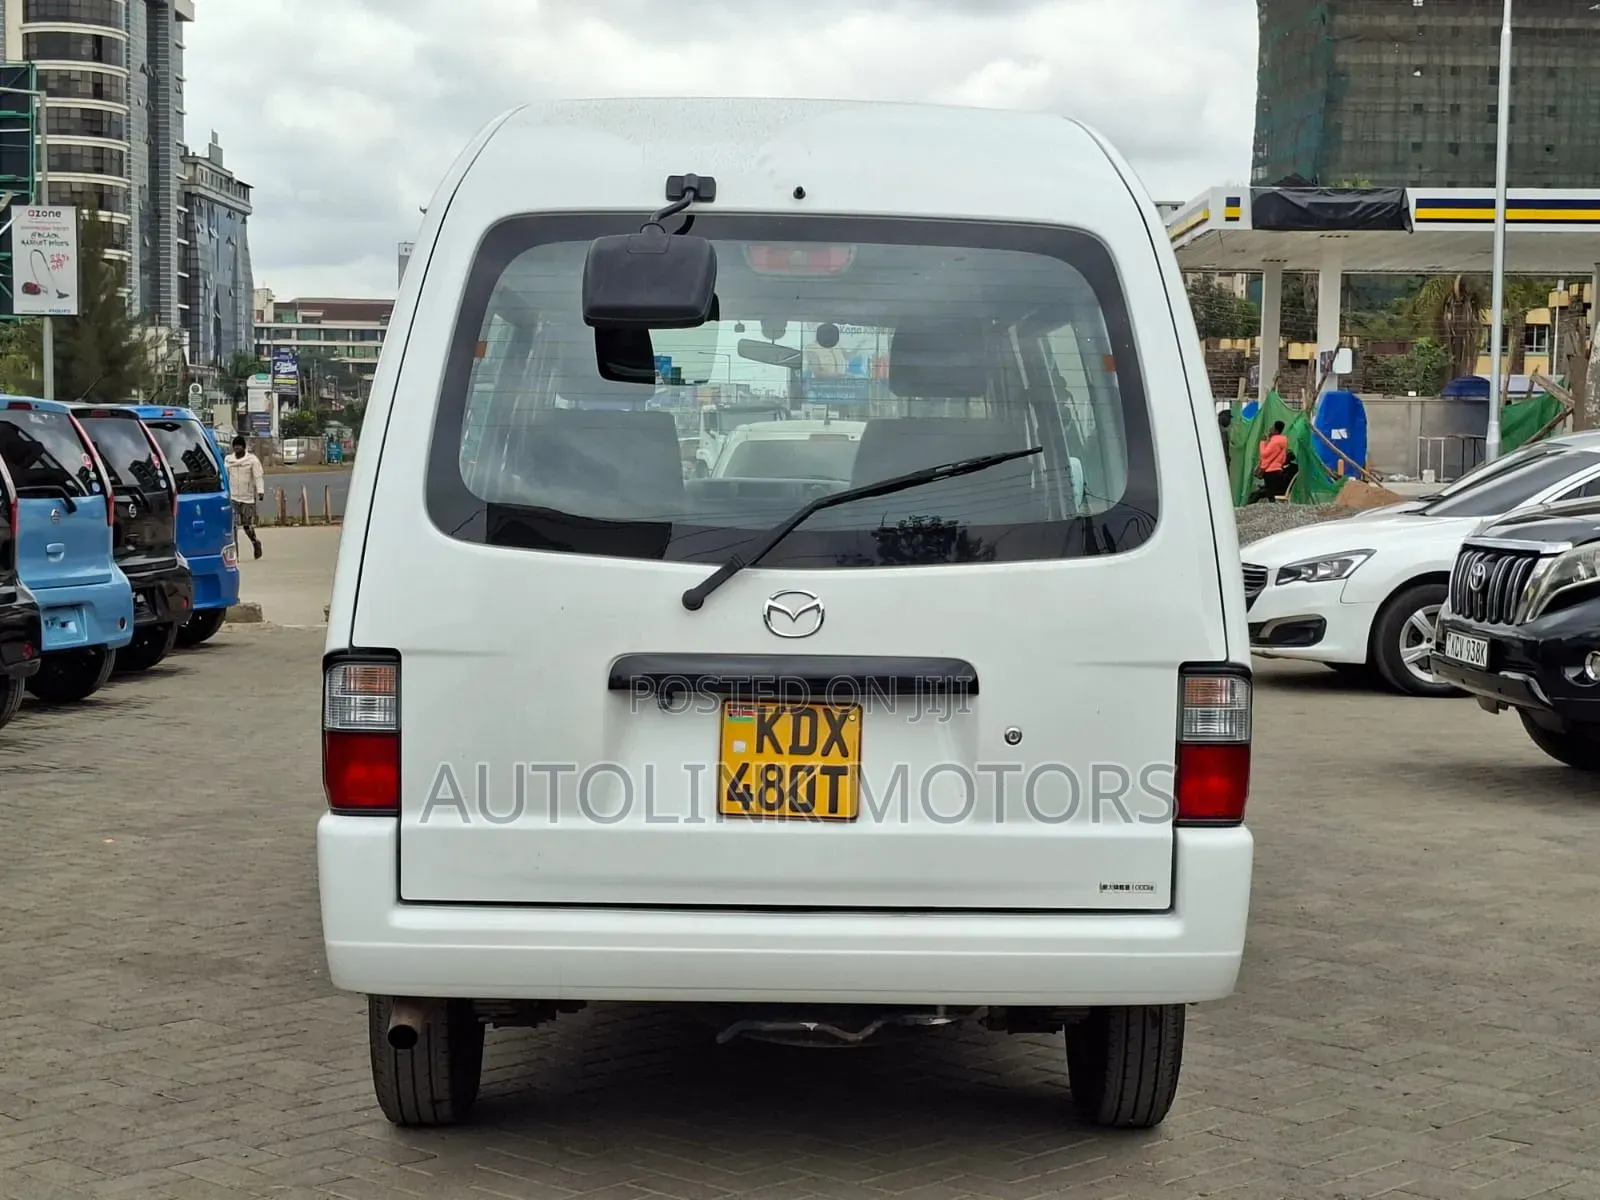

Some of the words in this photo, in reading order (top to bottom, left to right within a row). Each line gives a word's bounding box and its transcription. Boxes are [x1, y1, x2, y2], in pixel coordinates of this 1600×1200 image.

[1467, 640, 1486, 664] 938K
[755, 706, 850, 758] KDX
[726, 763, 849, 815] 480T
